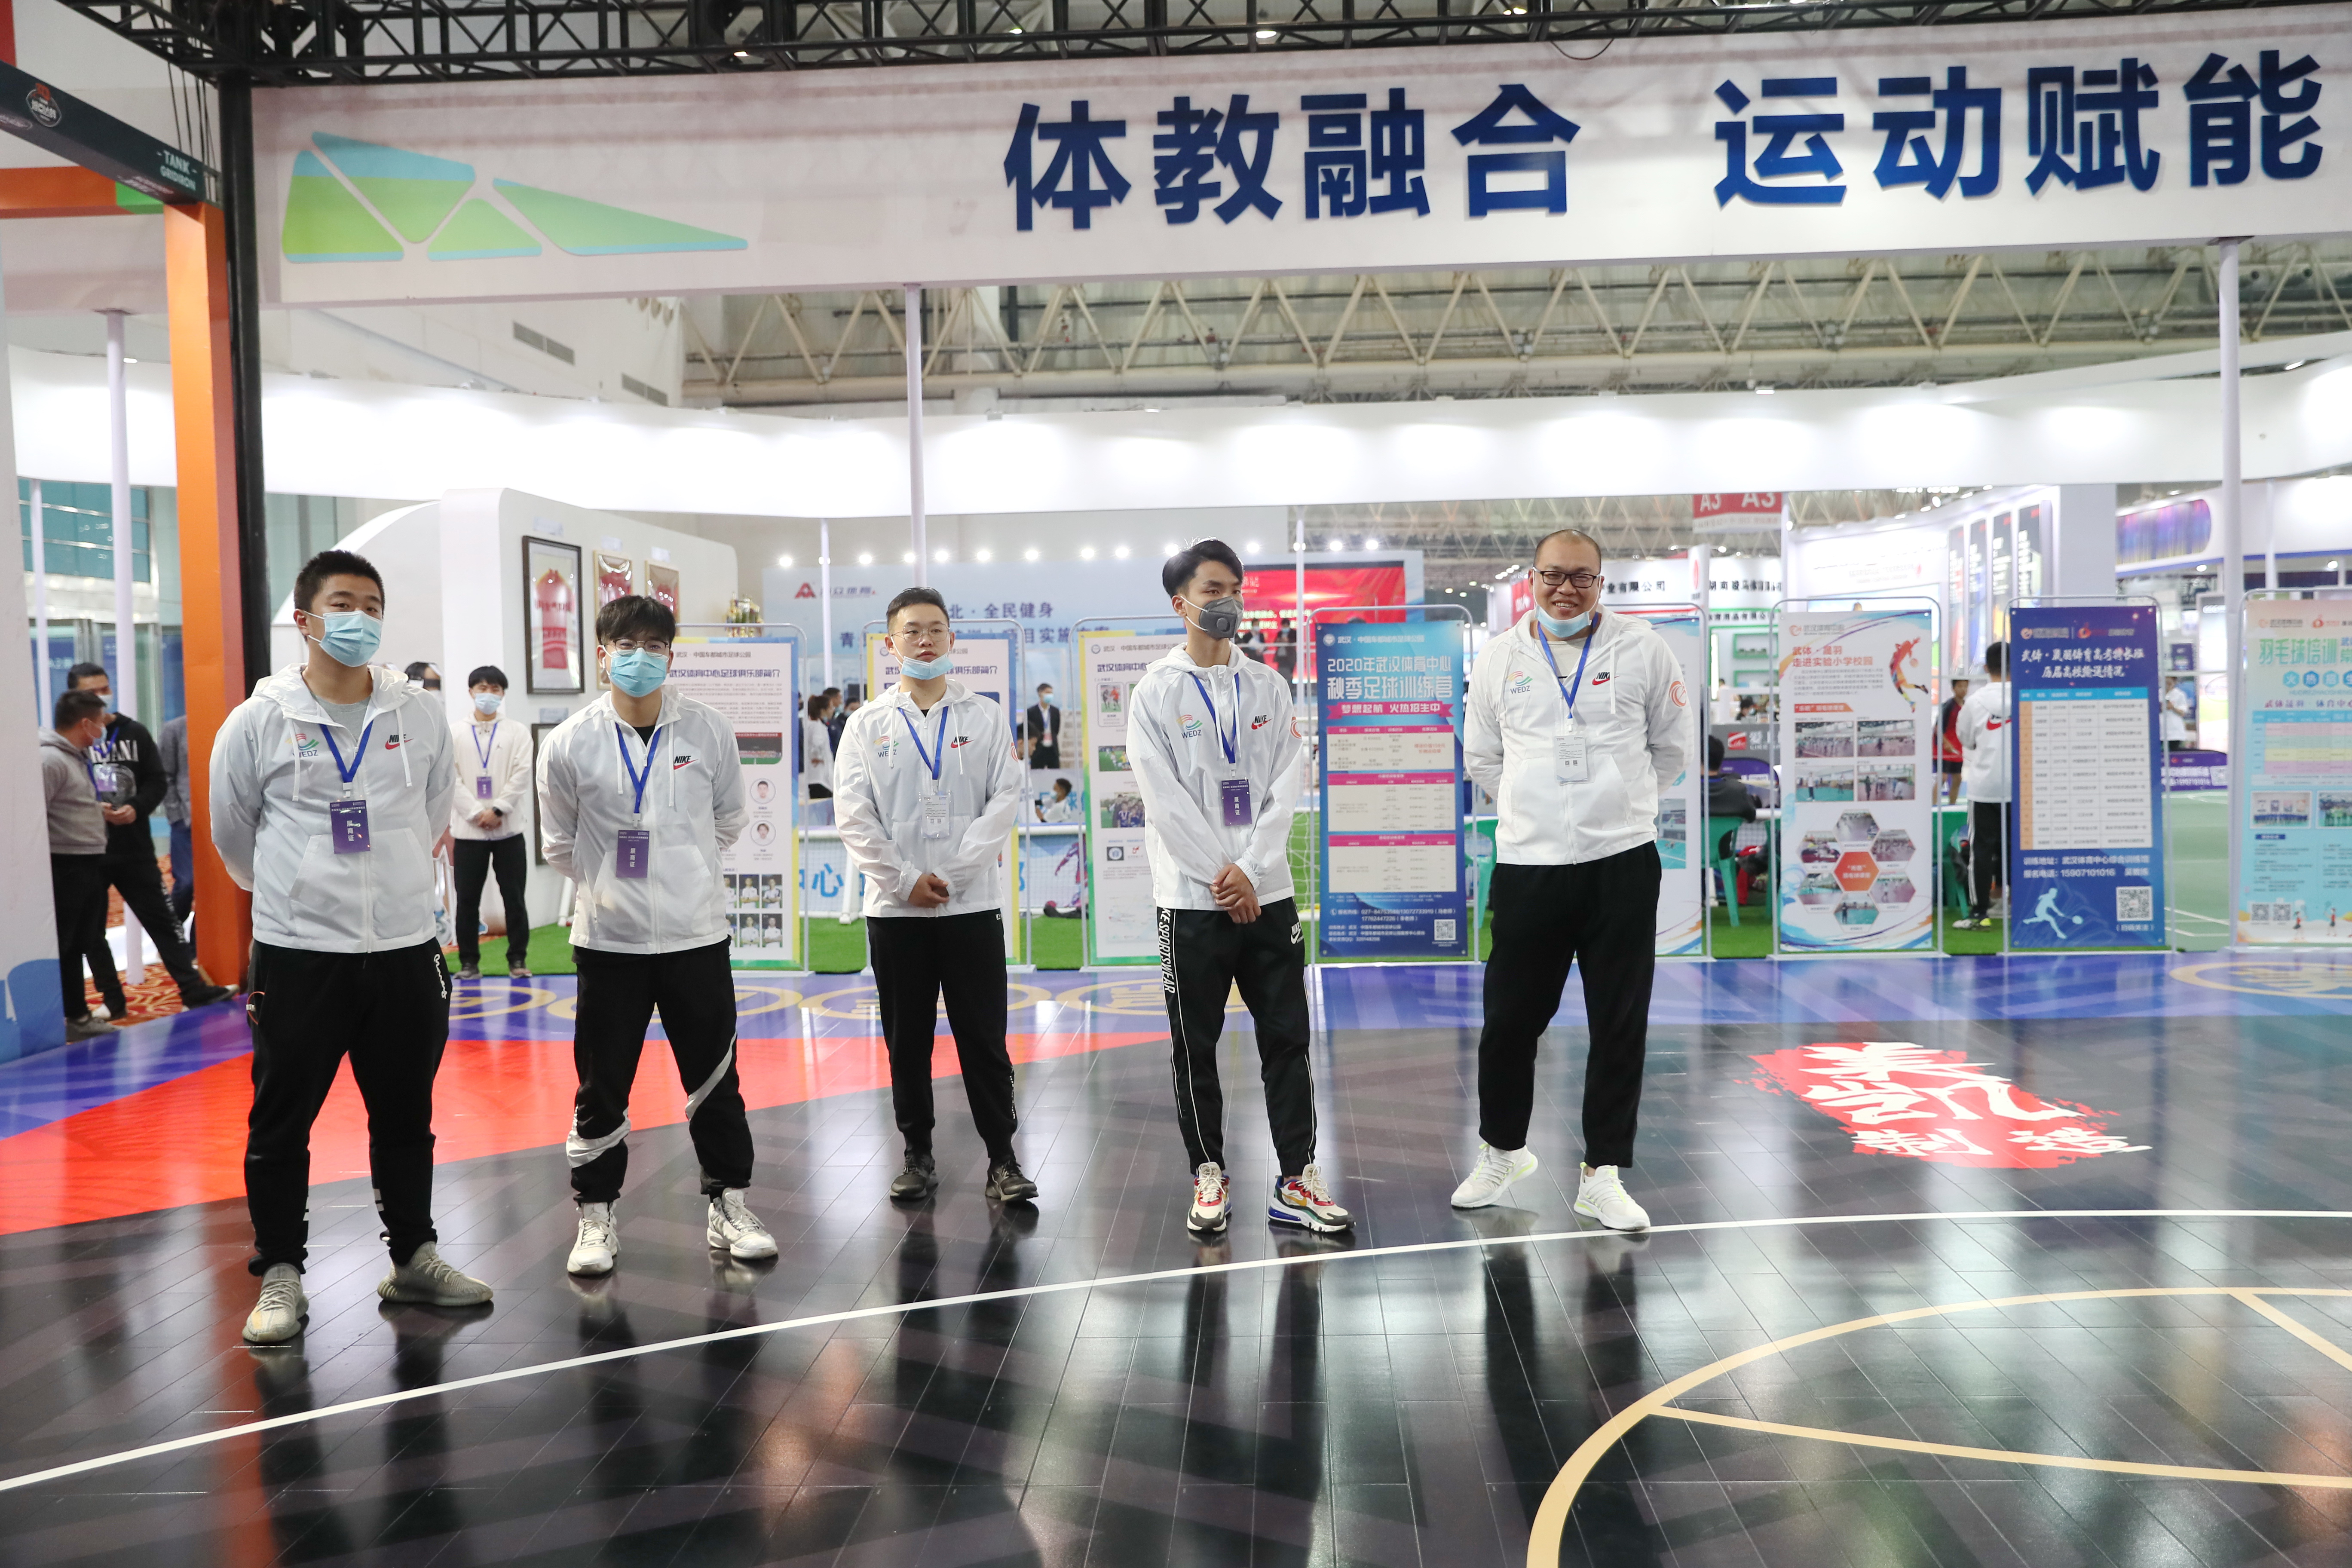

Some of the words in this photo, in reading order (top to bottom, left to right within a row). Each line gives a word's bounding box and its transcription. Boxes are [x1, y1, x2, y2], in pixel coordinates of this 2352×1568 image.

[1004, 83, 1582, 231] 体教融合
[1712, 49, 2323, 211] 运动赋能
[164, 150, 190, 175] TANK
[1602, 580, 1665, 594] 业有限公司
[2259, 638, 2337, 665] 羽毛球培训
[1327, 656, 1452, 673] 2020年武汉体育中心
[669, 669, 781, 678] 武汉体育中心足球俱乐部简介
[1327, 675, 1453, 700] 秋季足球训练营
[1510, 685, 1531, 695] WEDZ
[1341, 703, 1383, 714] 梦想起航
[1389, 702, 1441, 713] 火热招生中
[1254, 715, 1268, 724] NIKE
[389, 733, 407, 743] NIE
[1181, 729, 1202, 739] WEDZ
[674, 755, 692, 764] NIKE
[878, 749, 897, 758] WEZ
[346, 820, 355, 841] 展商证
[1158, 922, 1176, 994] SPORTSWEAR
[1851, 1127, 2153, 1156] 制造
